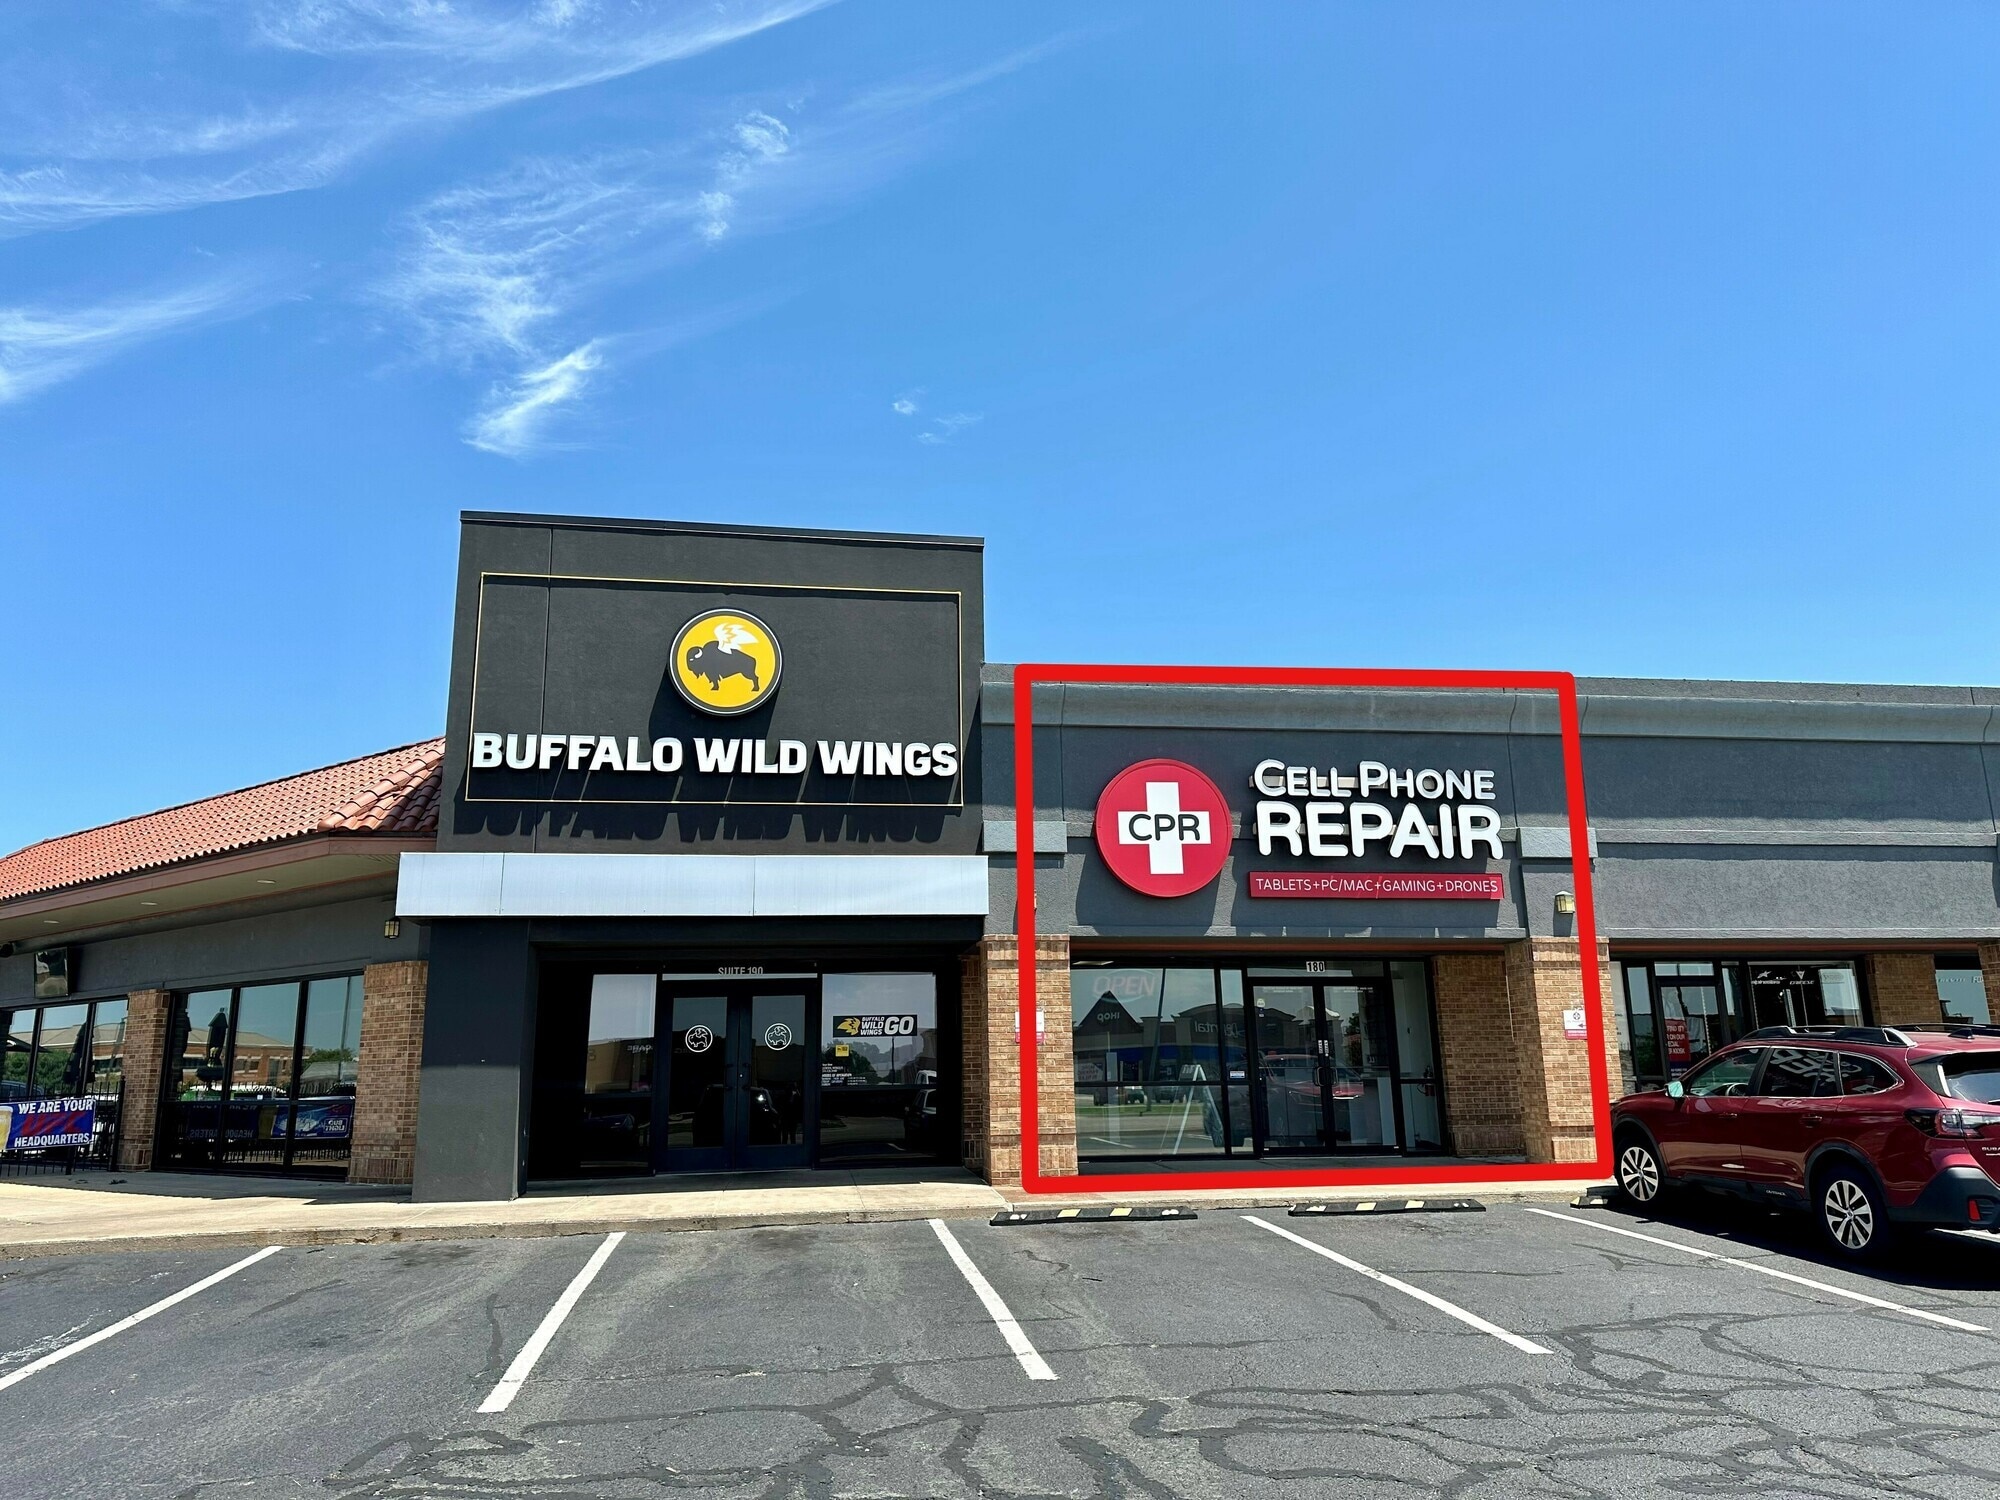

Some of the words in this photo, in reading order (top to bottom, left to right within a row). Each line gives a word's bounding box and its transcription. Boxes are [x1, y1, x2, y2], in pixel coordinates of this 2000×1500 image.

[472, 732, 683, 773] BUFFALO
[693, 737, 807, 775] WILD
[817, 740, 958, 777] WINGS
[1254, 759, 1352, 798] CELL
[1359, 760, 1496, 800] PHONE
[1129, 813, 1201, 842] CPR
[1255, 800, 1504, 860] REPAIR
[718, 966, 746, 976] SUITE
[747, 966, 764, 976] 190
[1307, 961, 1324, 972] 180
[1092, 975, 1156, 996] OPEN
[860, 1028, 883, 1036] WINGS
[861, 1021, 884, 1029] WILD
[884, 1016, 914, 1035] GO
[18, 1102, 37, 1115] WE
[37, 1100, 61, 1114] ARE
[62, 1098, 93, 1112] YOUR
[14, 1132, 90, 1148] HEADQUARTERS
